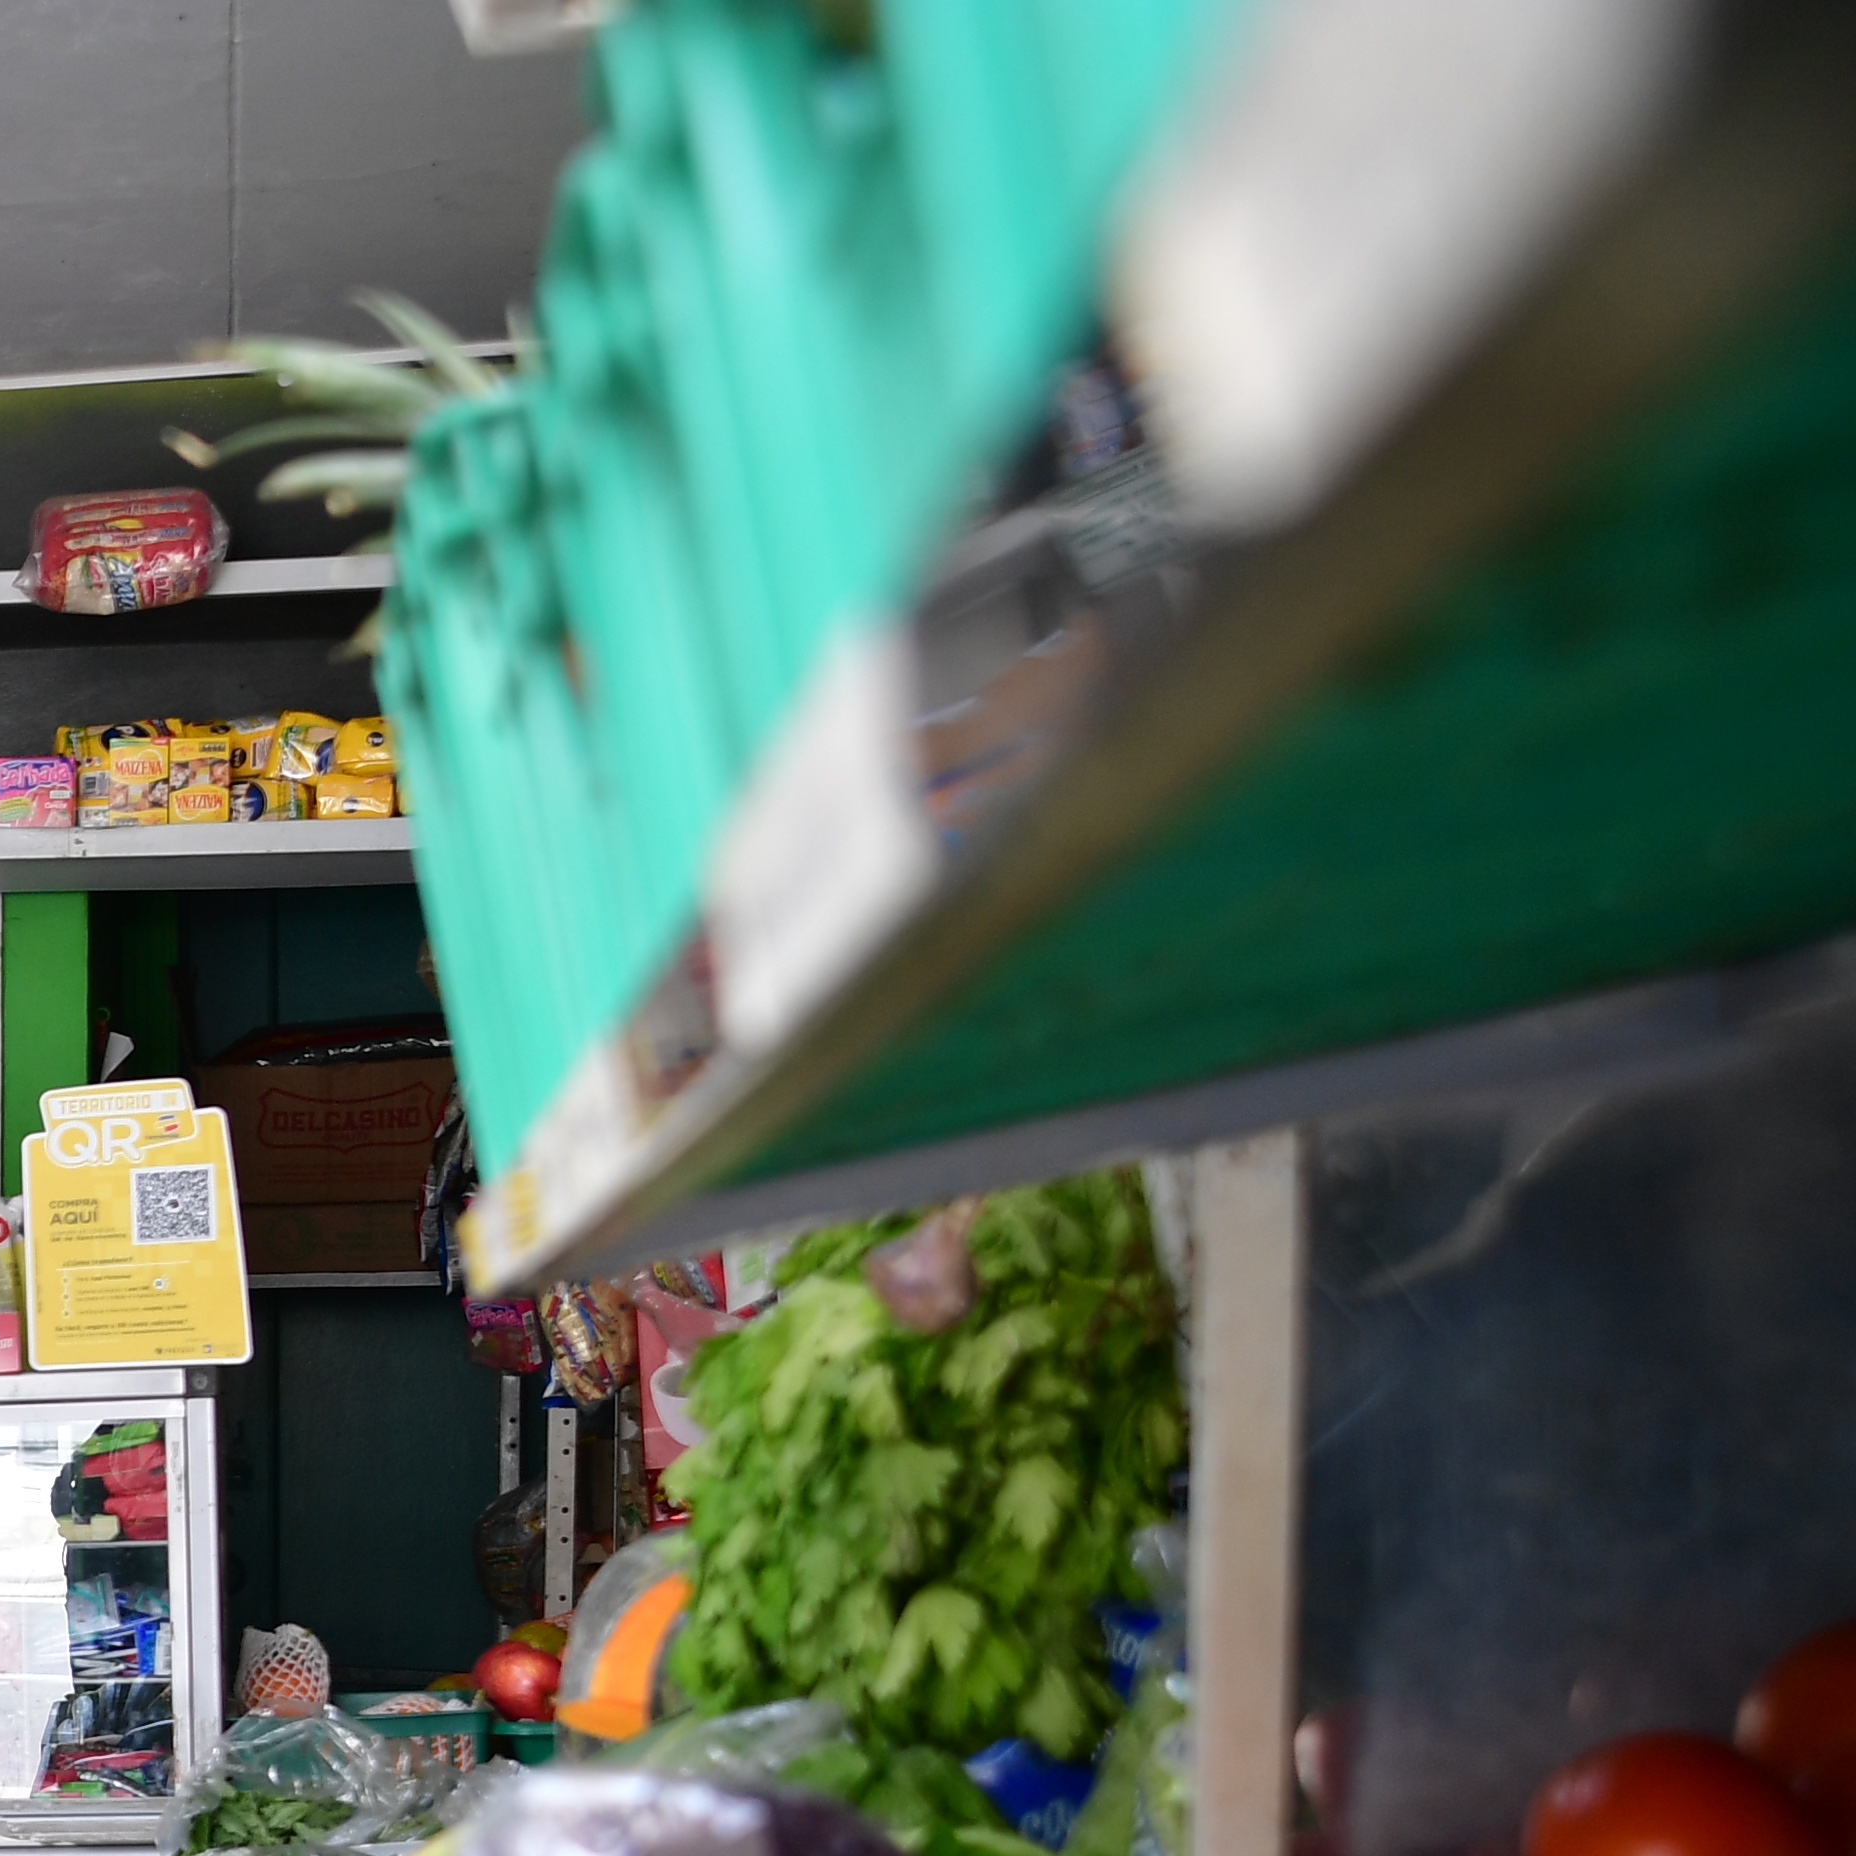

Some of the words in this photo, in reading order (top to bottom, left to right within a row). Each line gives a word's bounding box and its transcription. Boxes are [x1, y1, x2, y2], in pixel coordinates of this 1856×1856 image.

[114, 760, 164, 777] MAIZENA
[175, 793, 224, 809] MAIZENA
[59, 1094, 151, 1115] TERRITORIO
[272, 1106, 420, 1132] DELCASINO
[49, 1117, 142, 1165] QR
[49, 1198, 99, 1210] COMPRA
[49, 1208, 99, 1226] AQUÍ
